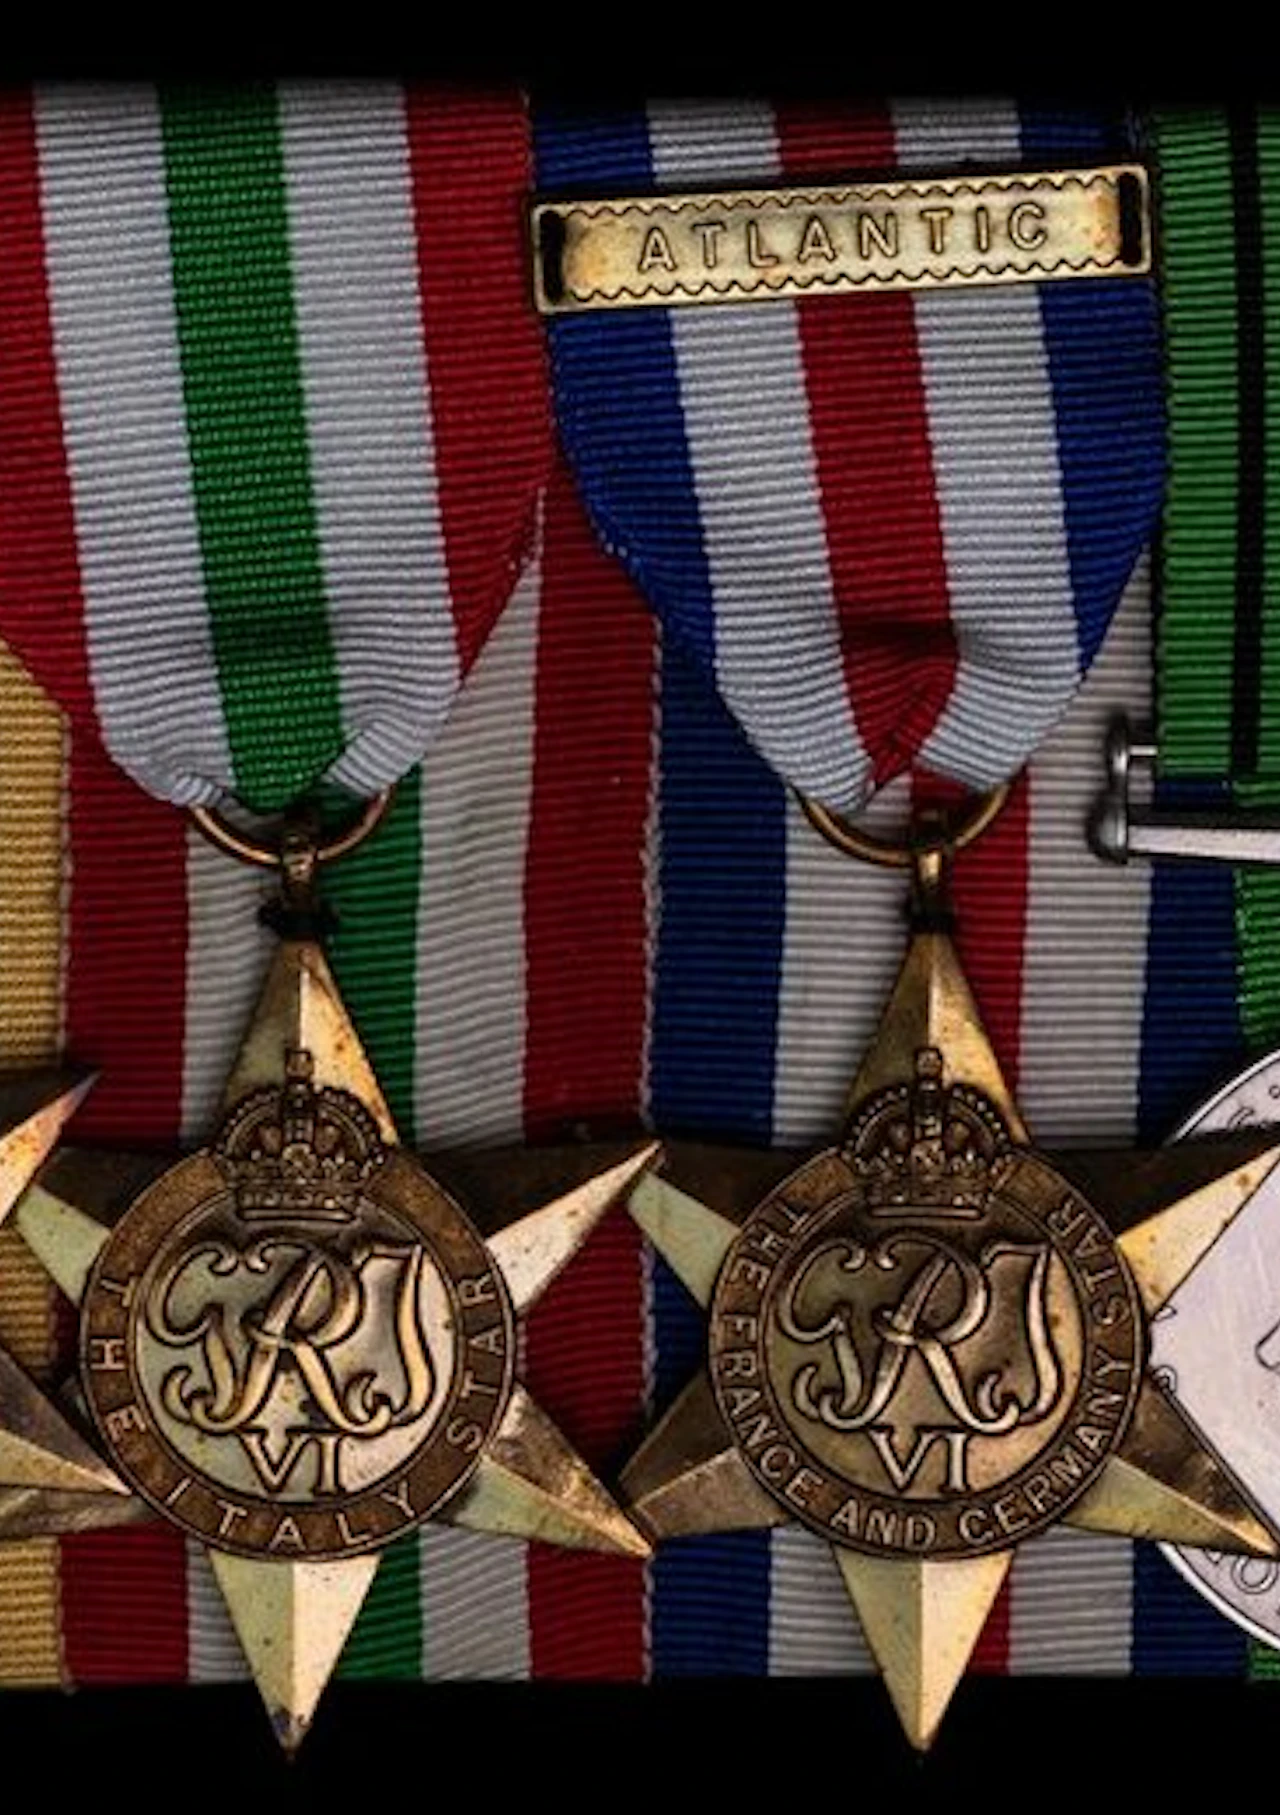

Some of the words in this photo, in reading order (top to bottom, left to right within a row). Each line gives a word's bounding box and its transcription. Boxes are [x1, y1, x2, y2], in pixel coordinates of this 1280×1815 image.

[637, 200, 1050, 275] ATLANTIC
[727, 1202, 810, 1291] THE
[1045, 1198, 1132, 1326] STAR
[89, 1274, 148, 1441] THE
[166, 1477, 419, 1550] ITALY
[446, 1270, 506, 1454] STAR
[721, 1312, 825, 1506] FRANCE
[237, 1429, 346, 1496] VI
[867, 1425, 971, 1494] VI
[829, 1498, 937, 1548] AND
